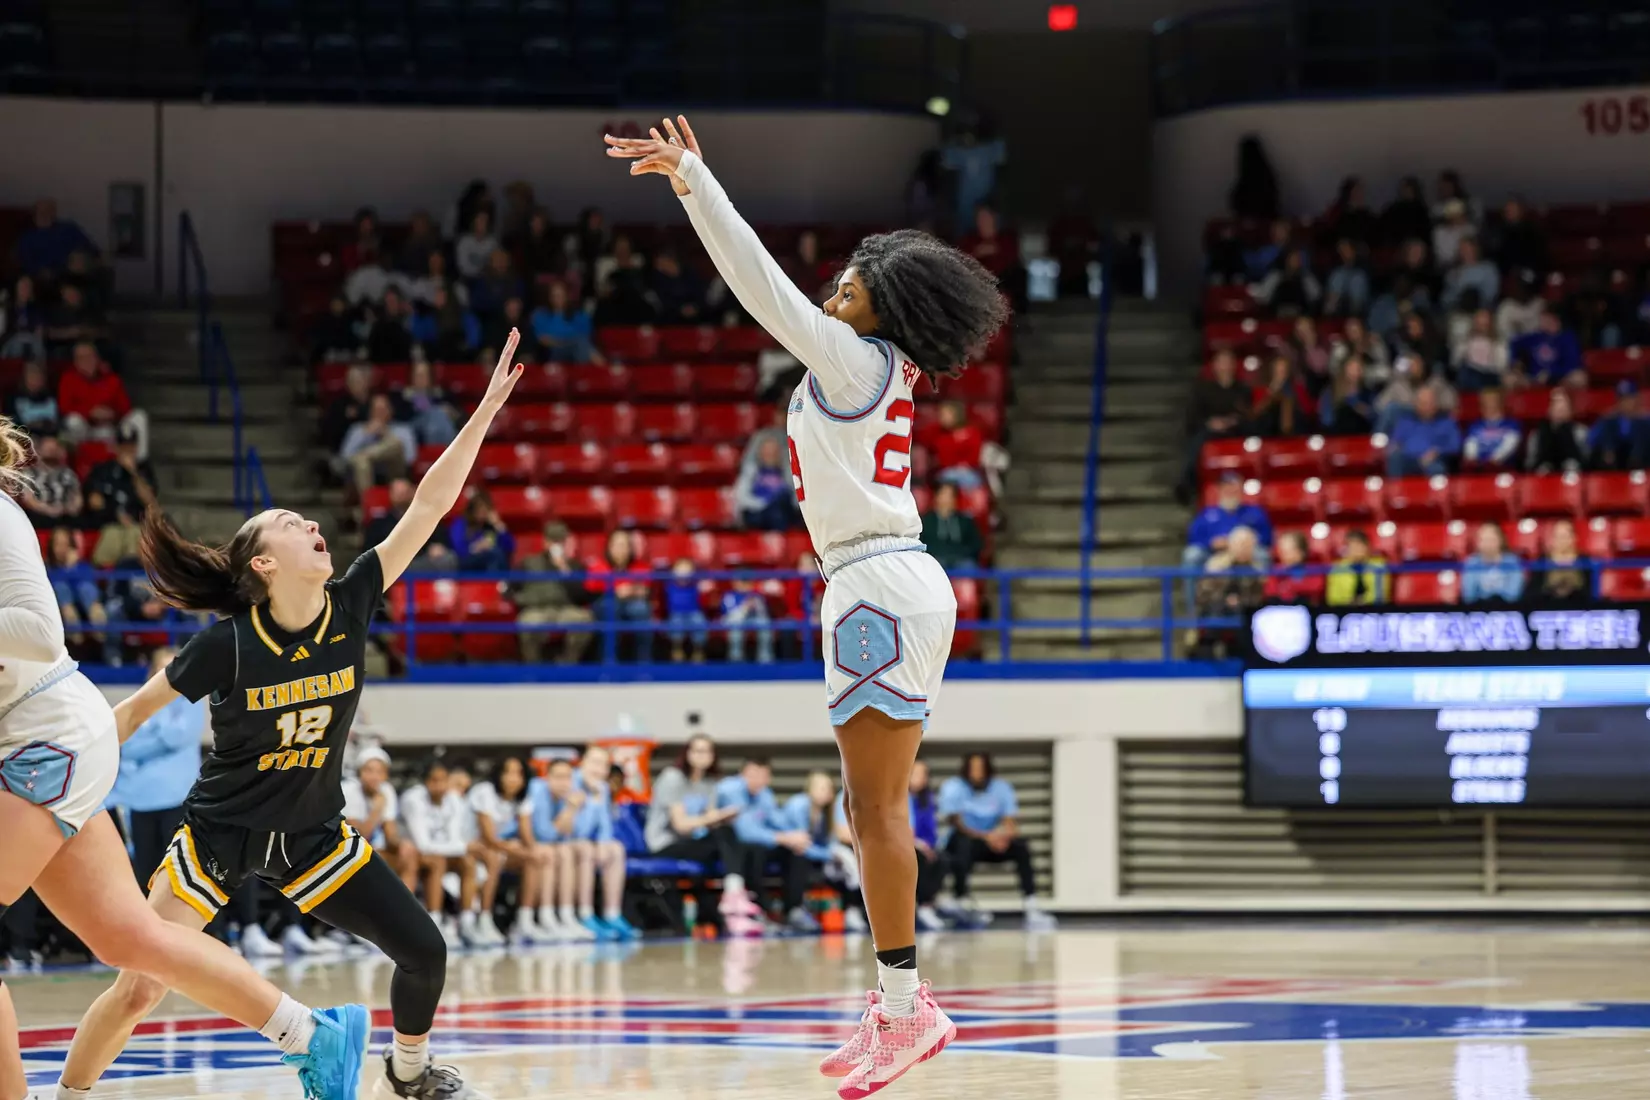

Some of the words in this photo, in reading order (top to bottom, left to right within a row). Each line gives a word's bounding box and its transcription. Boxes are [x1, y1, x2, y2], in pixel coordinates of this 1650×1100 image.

[1578, 96, 1649, 136] 105
[872, 398, 913, 489] 2
[1316, 612, 1531, 653] LOUISIANA
[1530, 610, 1640, 649] TECH
[245, 665, 355, 711] KENNESAW
[276, 705, 333, 749] 12
[257, 747, 329, 772] STATE
